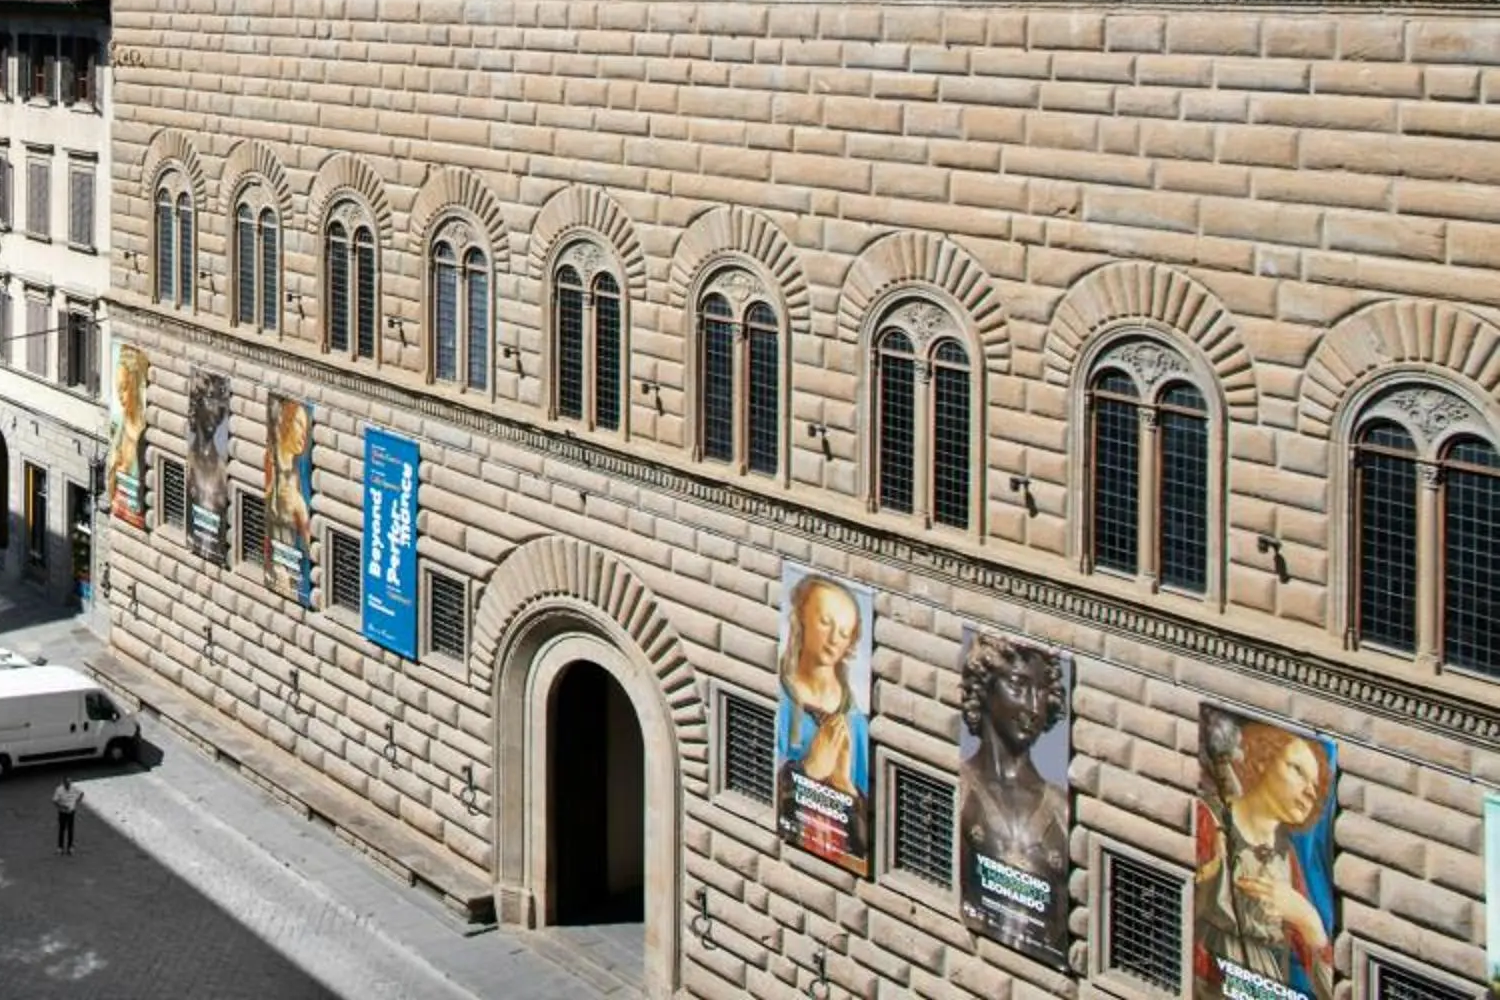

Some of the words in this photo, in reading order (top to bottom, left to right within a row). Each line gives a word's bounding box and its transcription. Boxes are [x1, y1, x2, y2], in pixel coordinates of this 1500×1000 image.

[369, 487, 384, 578] Beyond
[400, 462, 413, 548] mance
[976, 853, 1051, 893] VERROCCHIO
[981, 875, 1045, 912] LEONARDO
